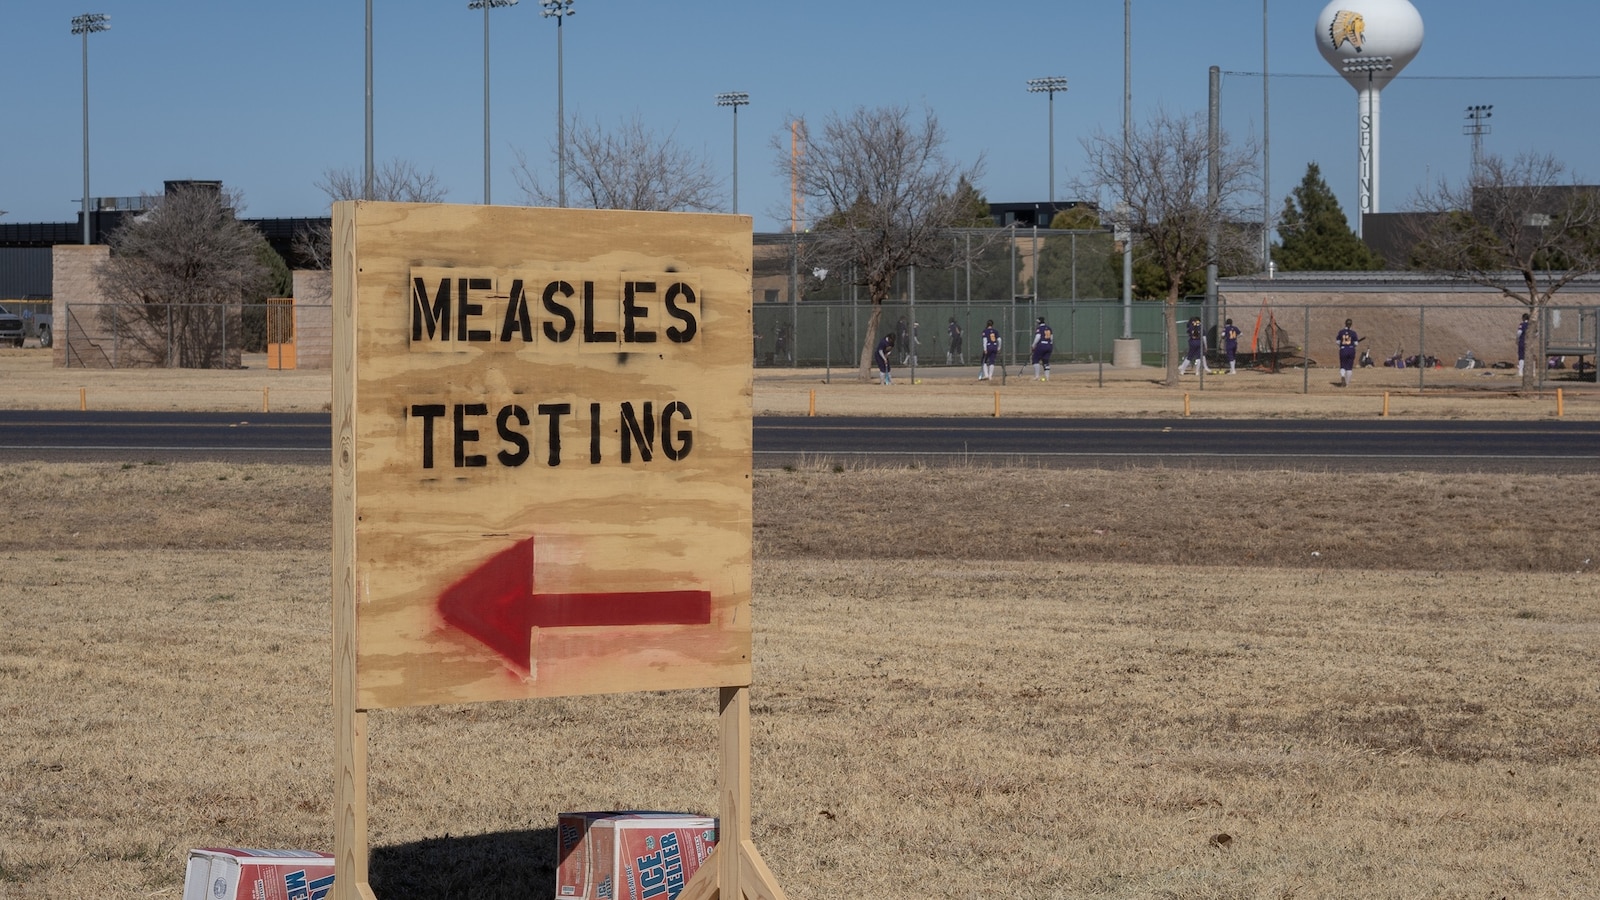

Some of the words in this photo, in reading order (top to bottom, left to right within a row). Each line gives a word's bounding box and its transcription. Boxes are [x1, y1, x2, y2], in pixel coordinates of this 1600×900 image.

[412, 278, 697, 343] MEASLES
[412, 401, 693, 468] TESTING
[637, 851, 667, 900] ICE
